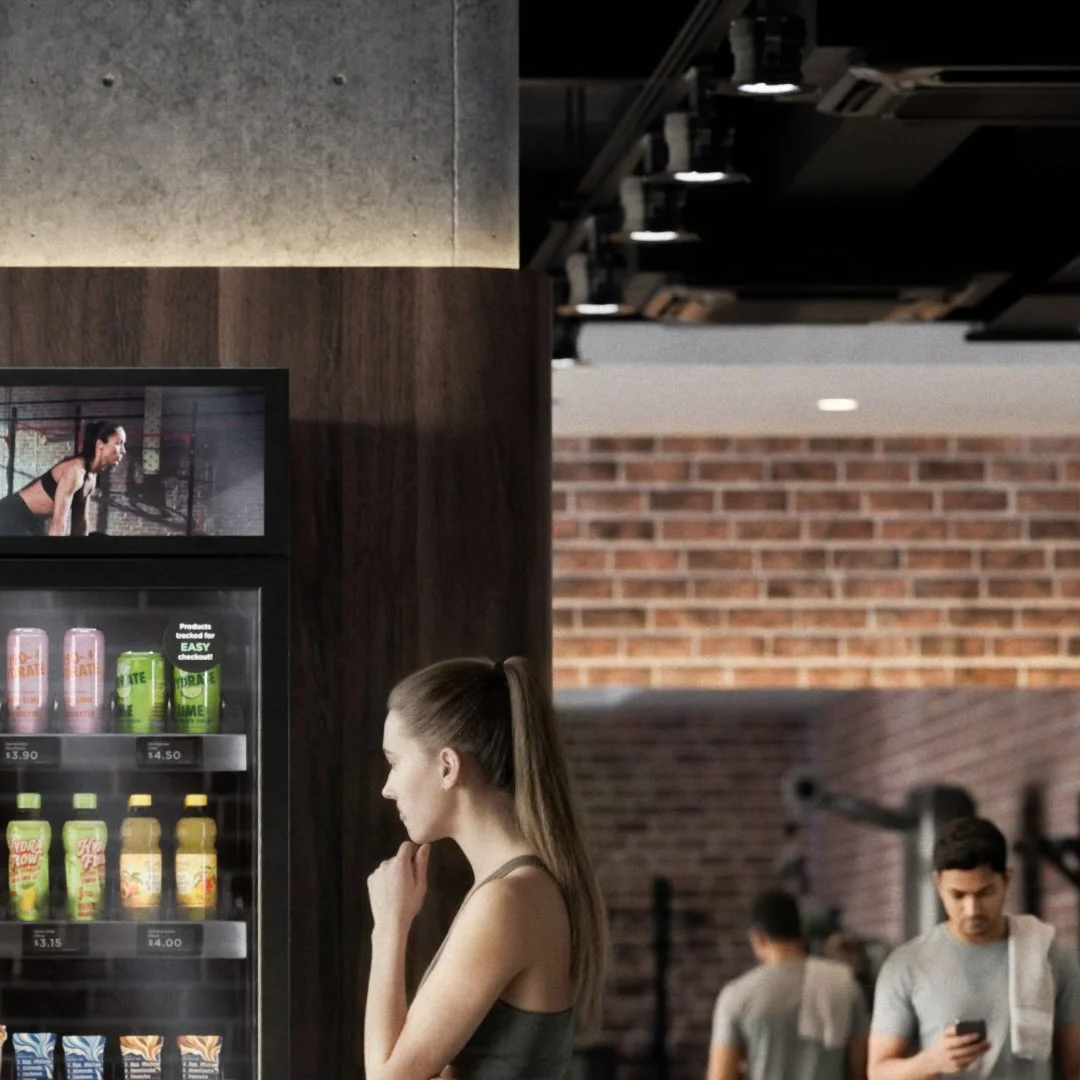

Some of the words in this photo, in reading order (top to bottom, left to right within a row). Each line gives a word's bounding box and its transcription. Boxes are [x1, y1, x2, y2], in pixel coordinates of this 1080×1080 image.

[179, 623, 211, 631] Products
[176, 632, 203, 640] tracked
[204, 632, 215, 640] for
[180, 642, 211, 652] EASY
[178, 653, 213, 661] checkout!
[5, 750, 39, 761] $3.90
[148, 750, 181, 761] $4.50
[33, 938, 62, 948] $3.15
[148, 938, 182, 948] $4.00
